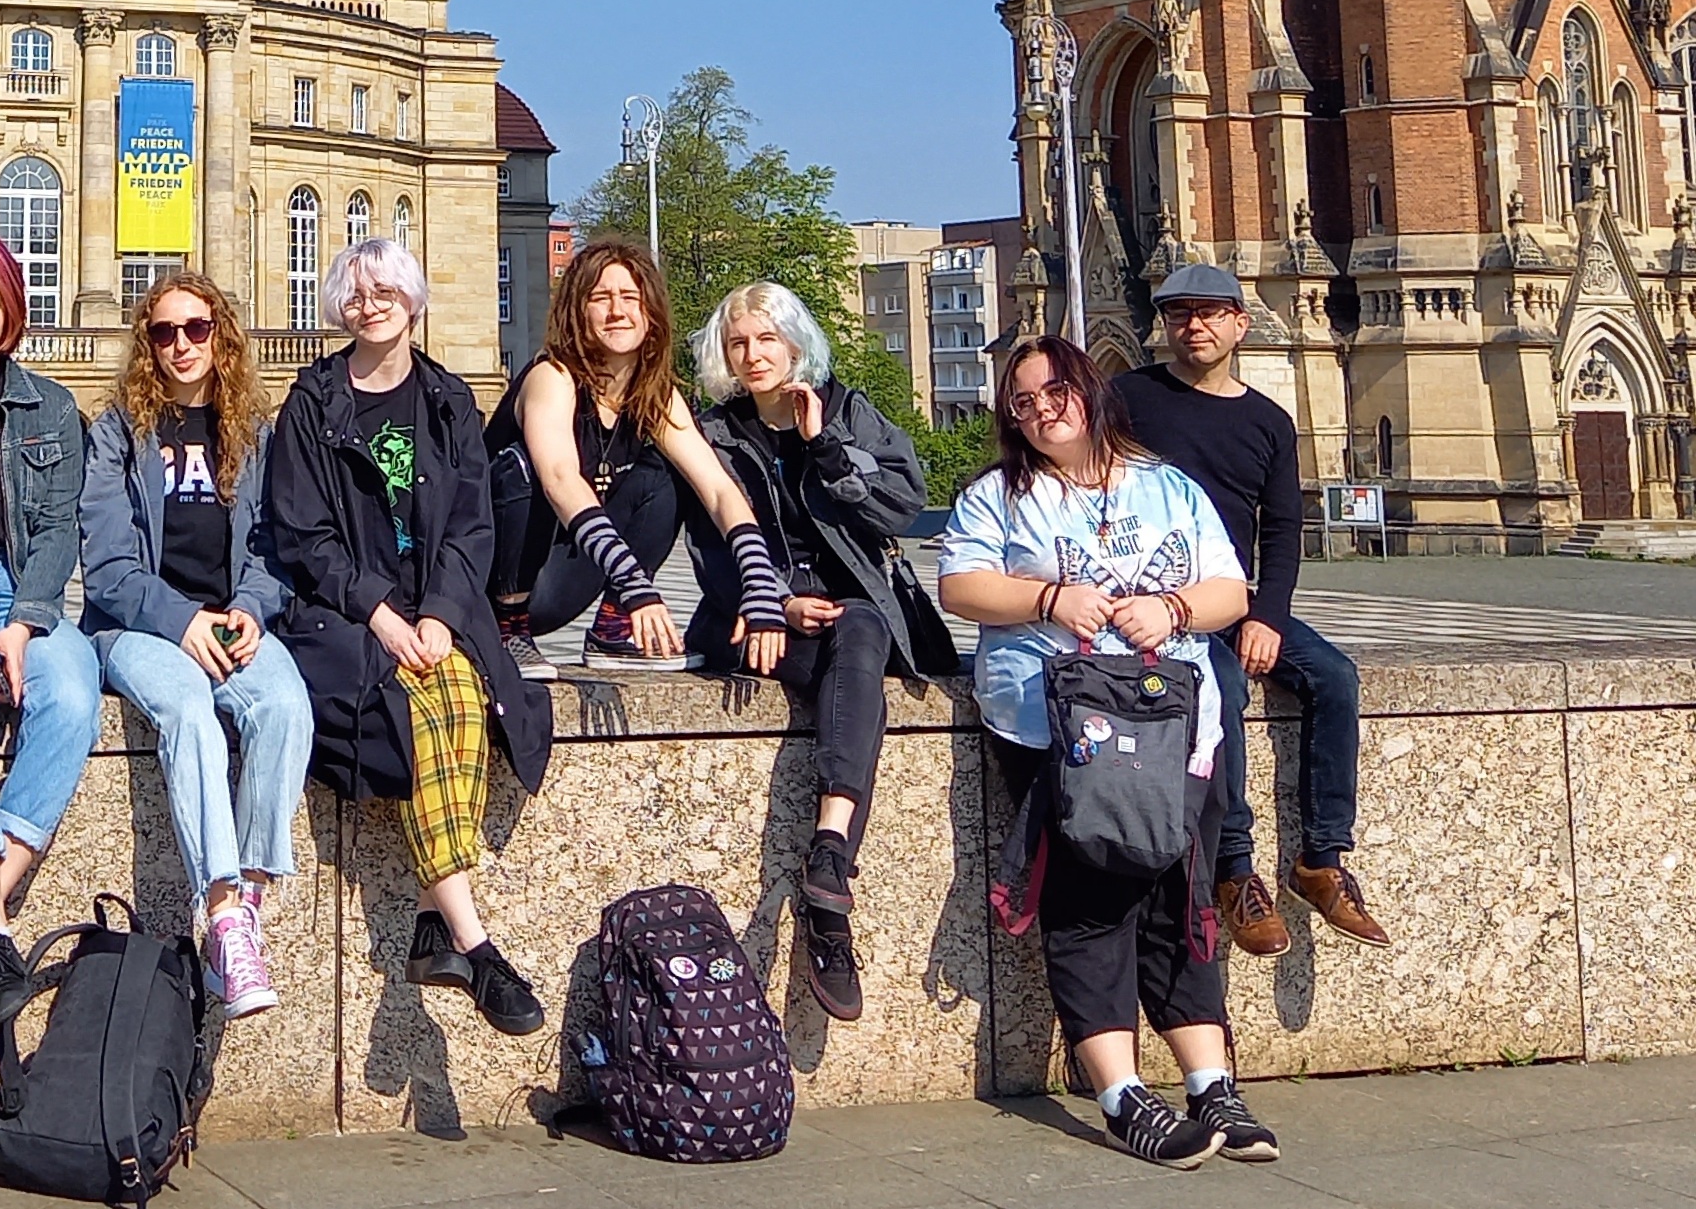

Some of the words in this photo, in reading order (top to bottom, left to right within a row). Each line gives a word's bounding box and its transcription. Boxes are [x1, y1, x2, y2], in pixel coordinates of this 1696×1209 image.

[140, 127, 174, 137] PEACE
[130, 137, 184, 150] FRIEDEN
[124, 151, 191, 175] МИР
[130, 178, 183, 189] FRIEDEN
[140, 190, 173, 200] PEACE
[1118, 515, 1142, 533] THE
